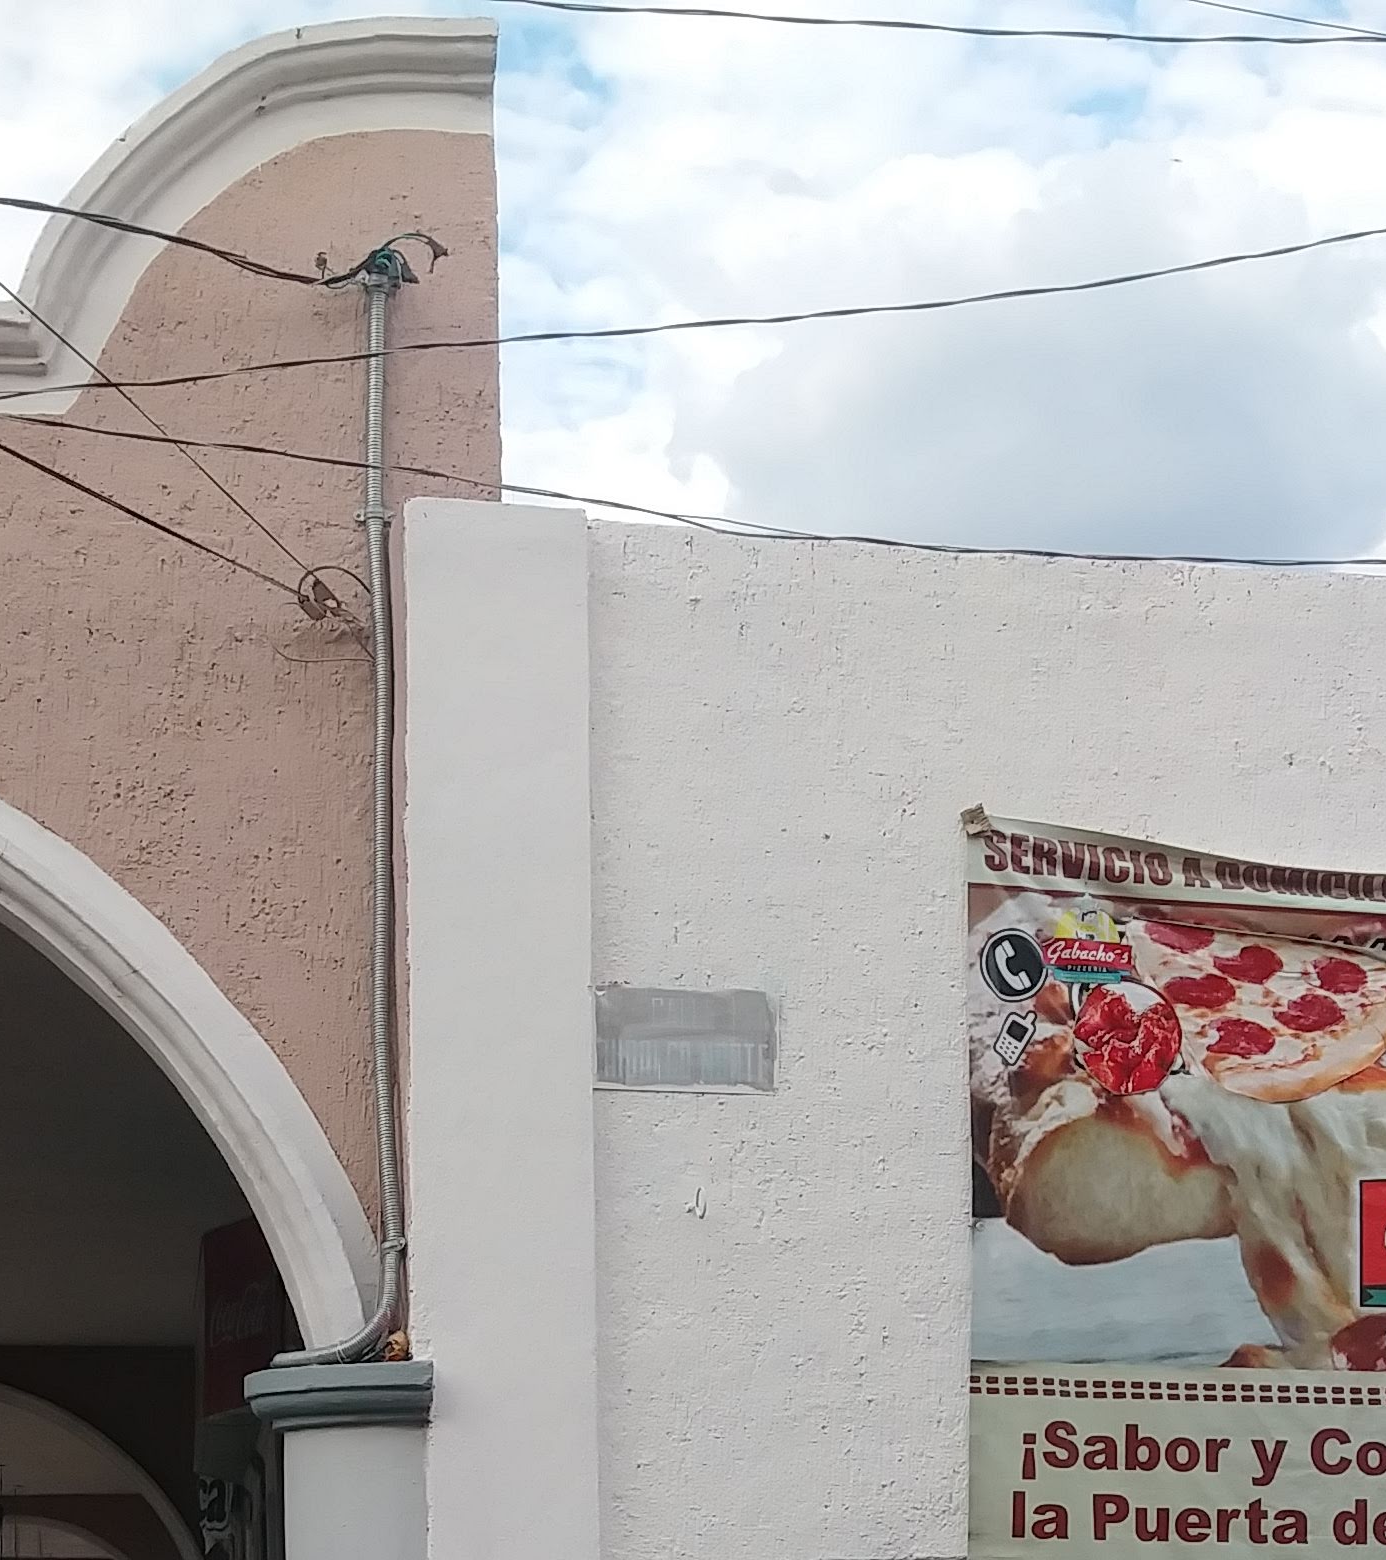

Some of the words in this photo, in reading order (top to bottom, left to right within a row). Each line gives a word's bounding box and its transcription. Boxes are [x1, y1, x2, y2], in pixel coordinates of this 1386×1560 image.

[983, 829, 1173, 887] SERVICIO
[1183, 857, 1212, 888] A
[1020, 1420, 1231, 1480] ¡Sabor
[1251, 1438, 1288, 1486] y
[1011, 1491, 1070, 1540] la
[1093, 1494, 1309, 1545] Puerta
